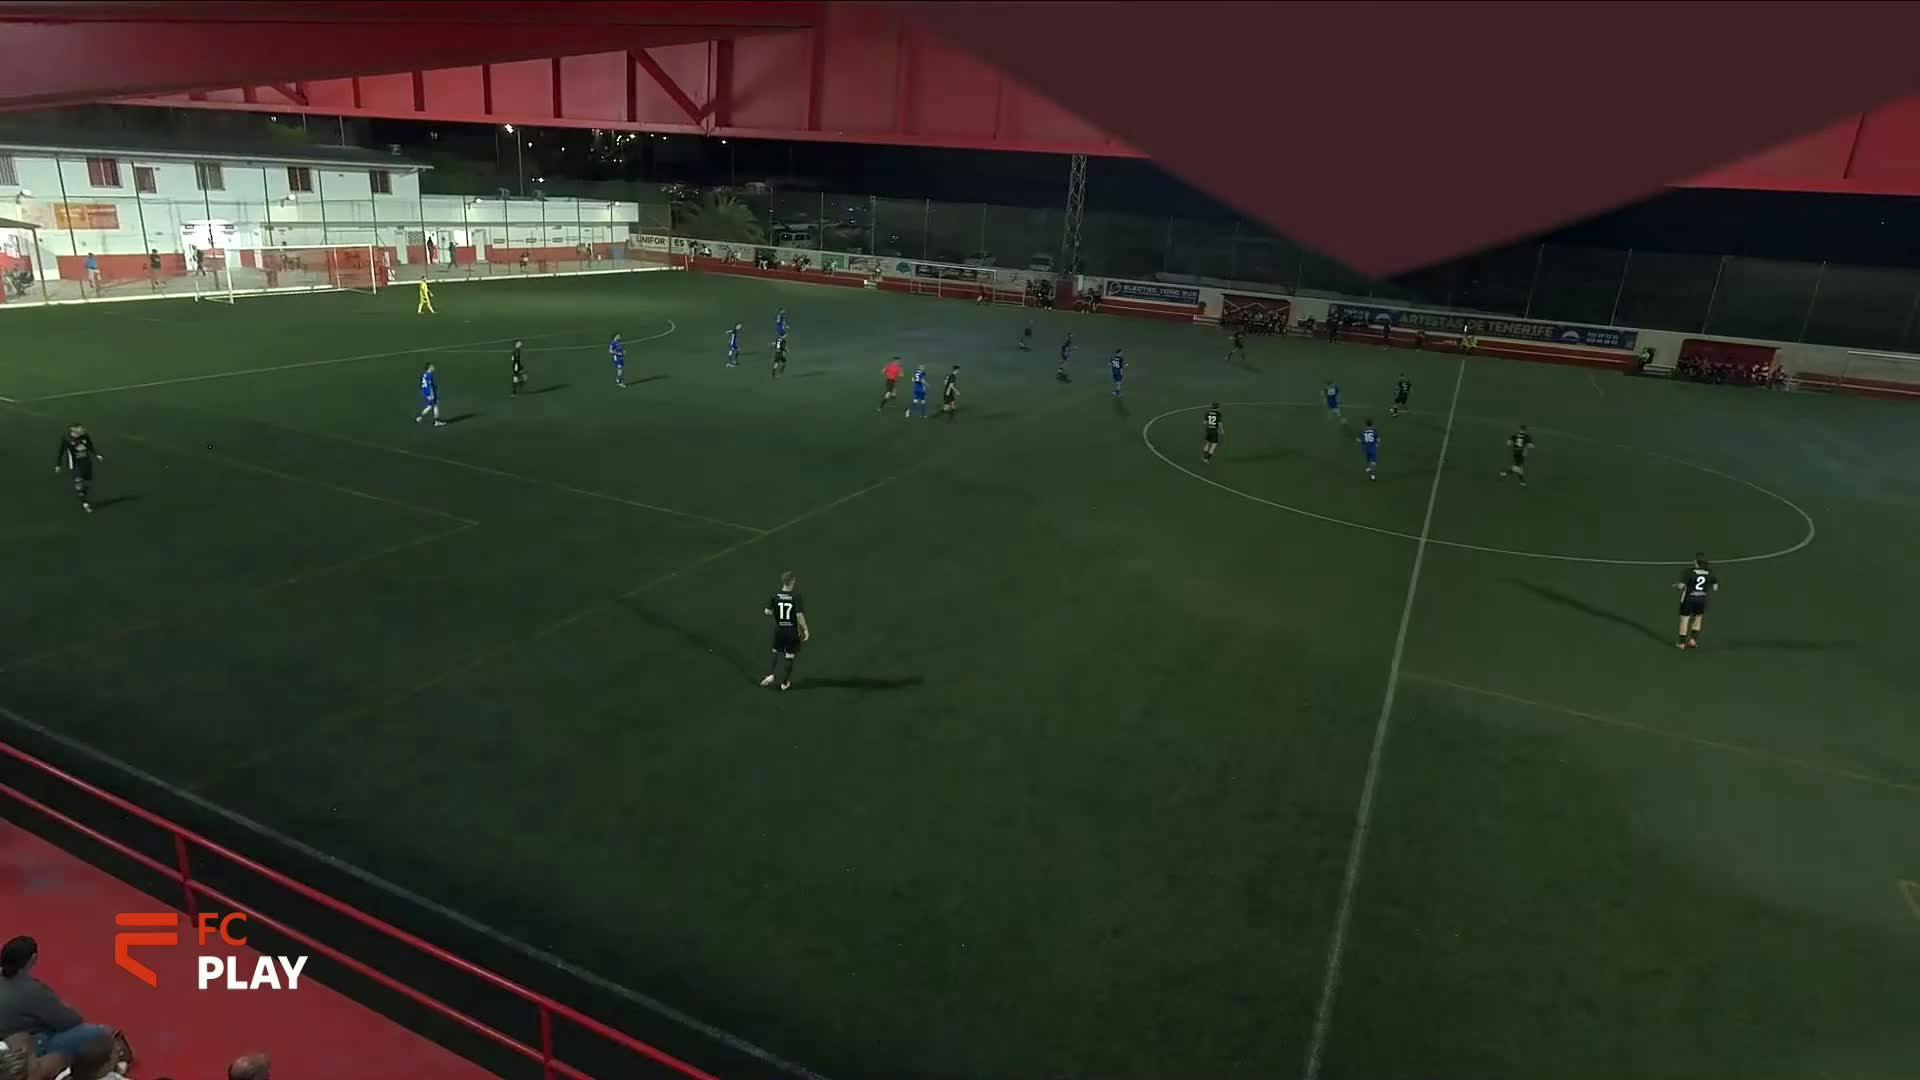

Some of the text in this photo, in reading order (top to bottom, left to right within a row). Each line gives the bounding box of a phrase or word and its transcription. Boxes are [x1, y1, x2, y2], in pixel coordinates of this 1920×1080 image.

[1207, 415, 1217, 426] 12
[1363, 432, 1375, 443] 16
[1695, 576, 1706, 591] 2
[777, 602, 794, 620] 17
